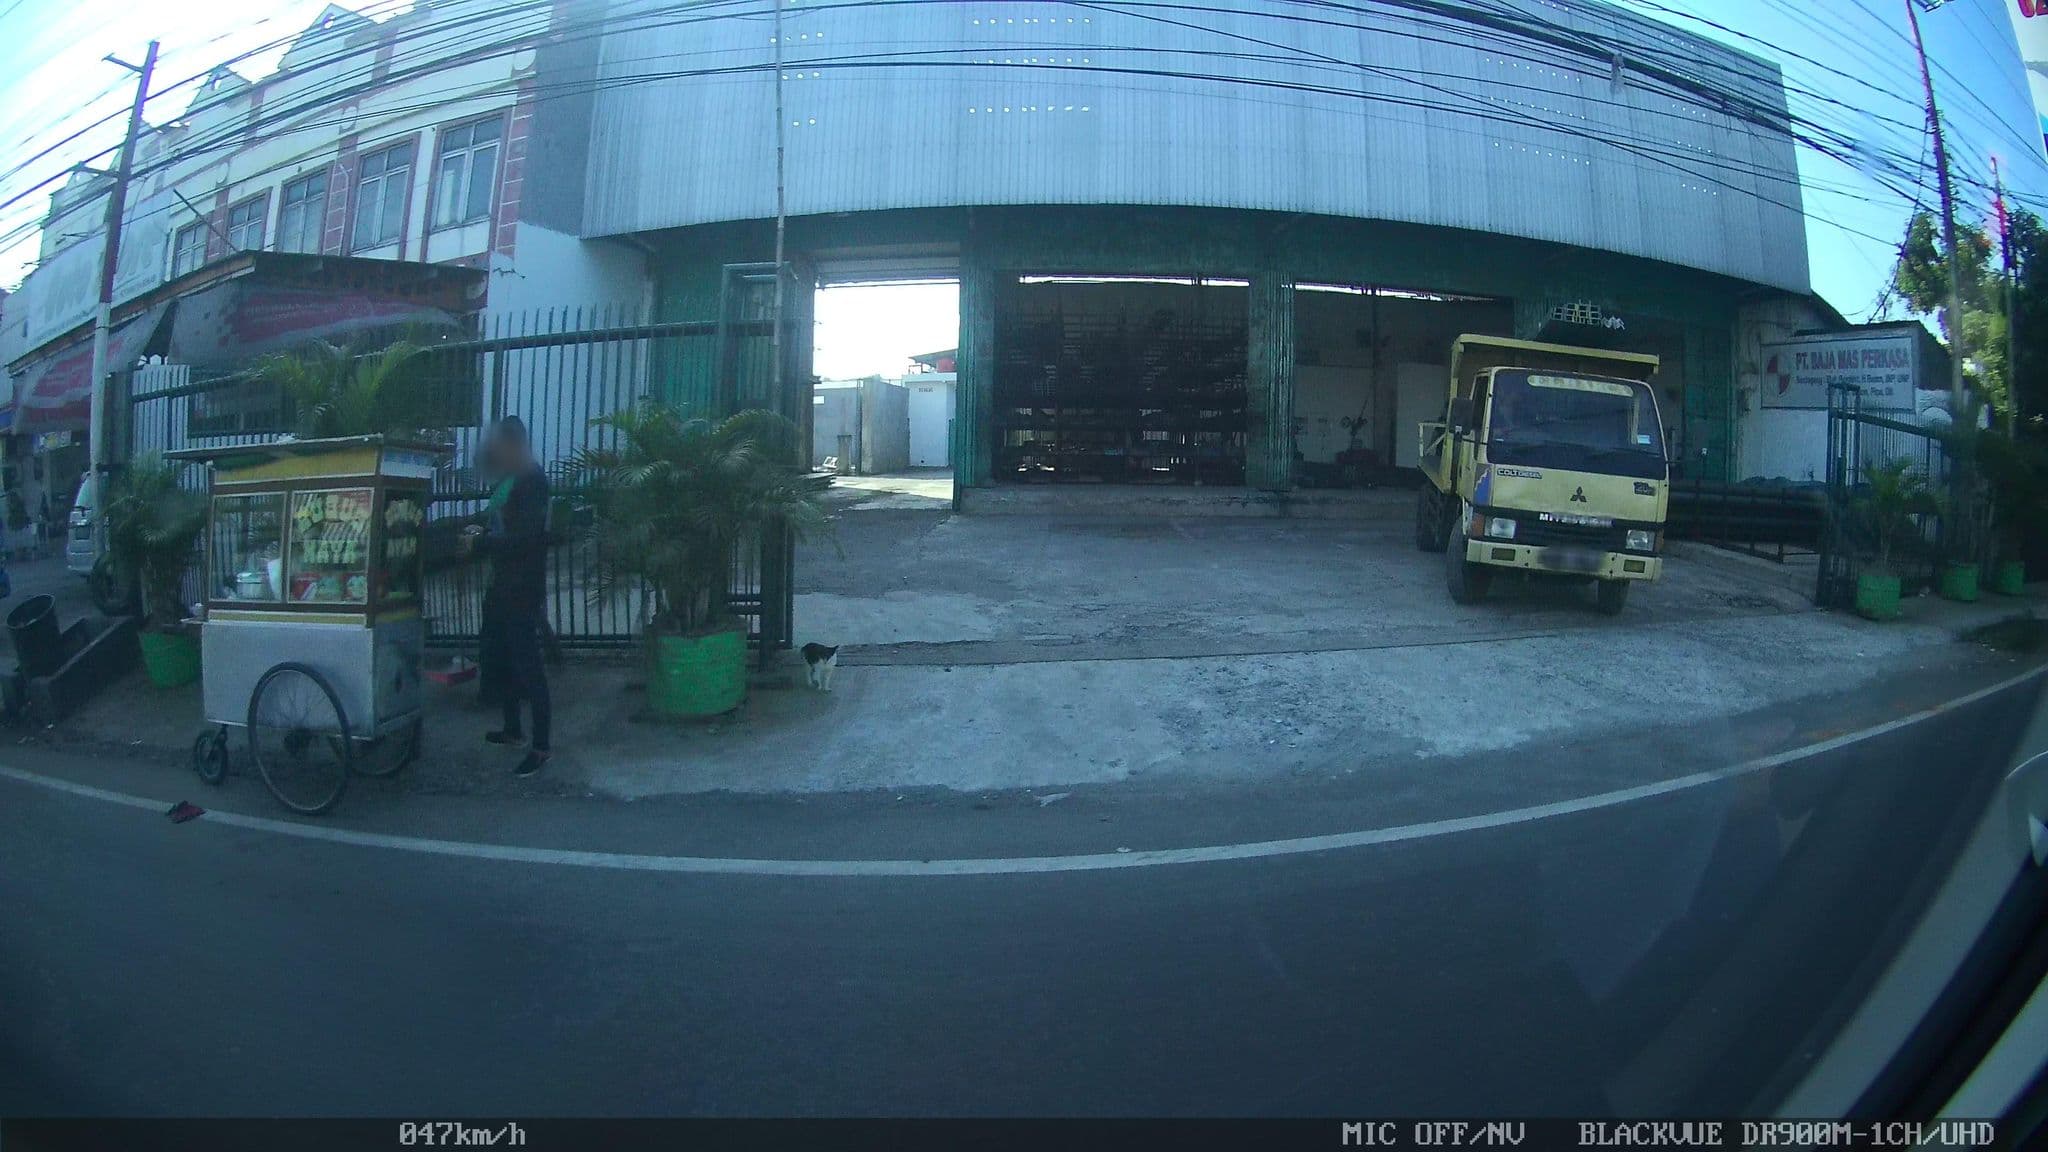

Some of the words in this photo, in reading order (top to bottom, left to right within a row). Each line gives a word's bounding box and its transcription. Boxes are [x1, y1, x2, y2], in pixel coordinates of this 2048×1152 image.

[1796, 352, 1809, 370] PT.
[1838, 350, 1859, 369] MAS
[1861, 348, 1910, 369] PERKASA
[1497, 467, 1519, 477] COLT
